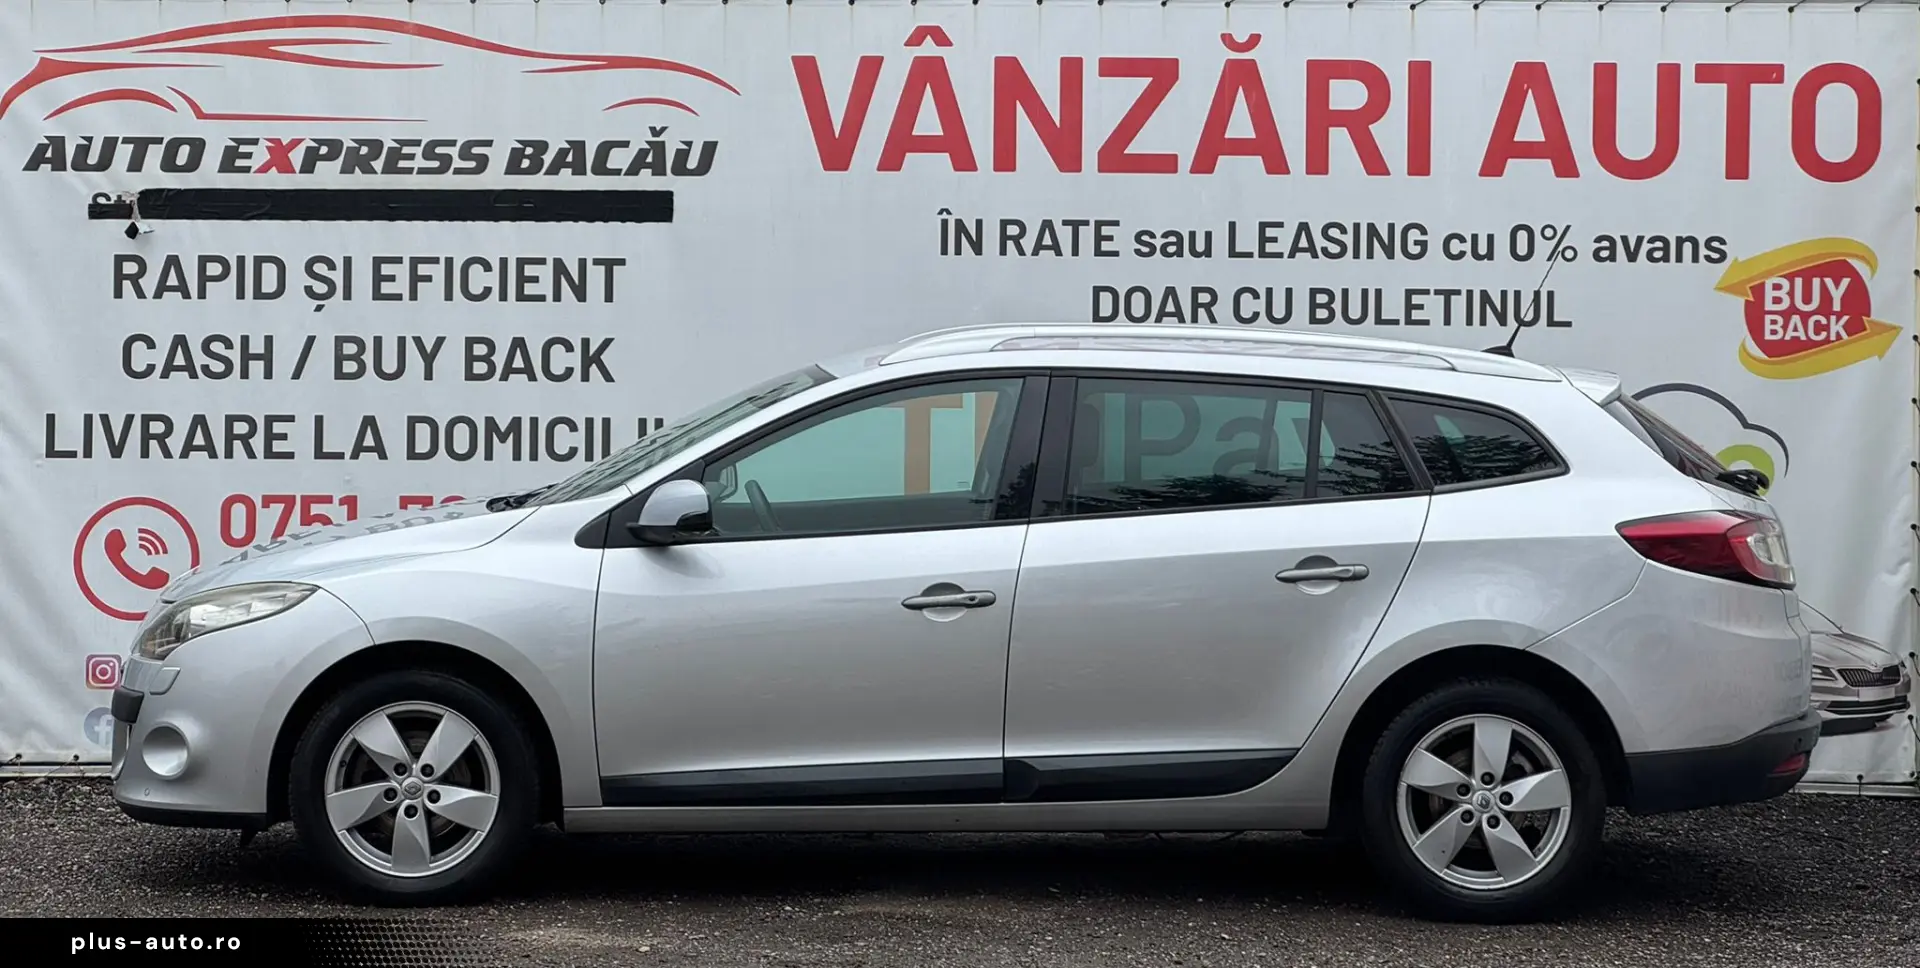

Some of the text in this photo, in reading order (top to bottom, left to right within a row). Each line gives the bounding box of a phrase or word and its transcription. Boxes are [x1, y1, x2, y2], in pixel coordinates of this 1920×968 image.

[791, 25, 1882, 183] VÂNZĂRI AUTO
[22, 125, 719, 177] AUTO EXPRESS BACĂU
[937, 207, 1728, 264] ÎN RATE sau LEASING cu 0% avans
[113, 253, 627, 313] RAPID ȘI EFICIENT
[1092, 285, 1573, 328] DOAR CU BULETINUL
[1764, 277, 1851, 312] BUY
[1764, 314, 1849, 341] BACK
[122, 333, 616, 383] CASH / BUY BACK
[44, 412, 296, 460] LIVRARE
[313, 414, 389, 461] LA
